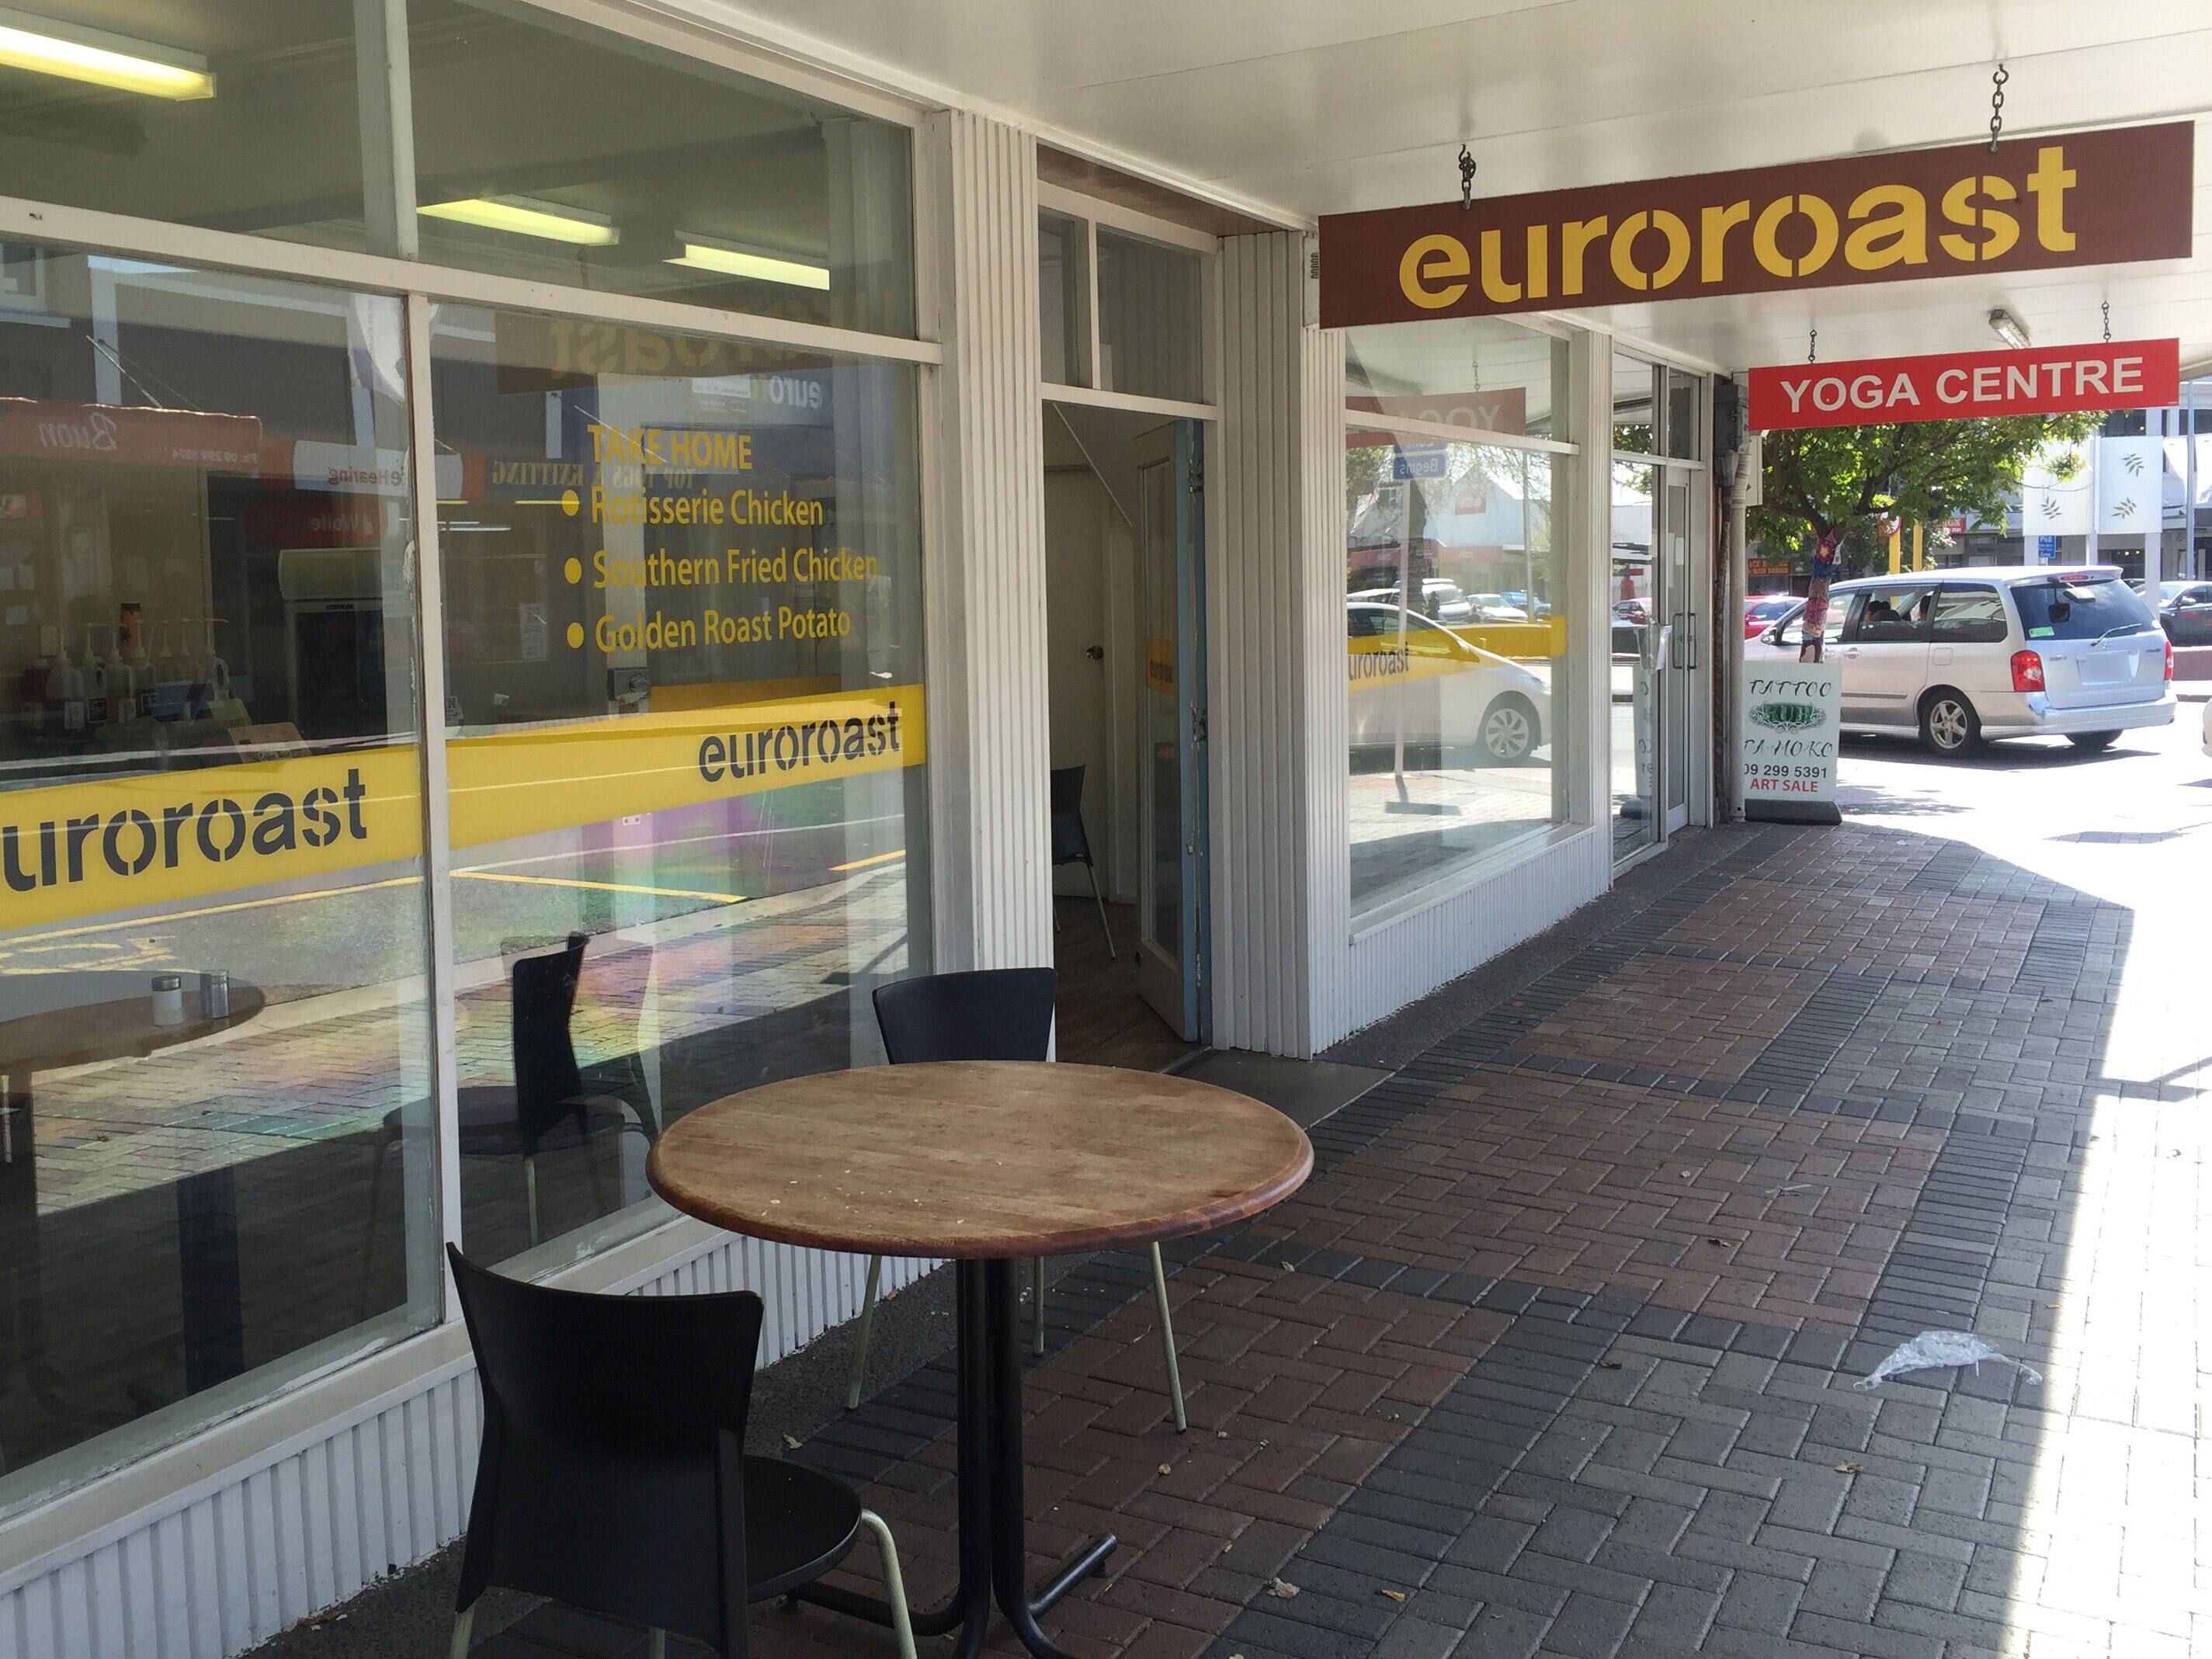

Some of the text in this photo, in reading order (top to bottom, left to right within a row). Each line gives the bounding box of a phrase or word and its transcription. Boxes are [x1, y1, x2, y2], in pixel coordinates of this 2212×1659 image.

[1398, 146, 2076, 309] euroroast
[1780, 356, 2144, 413] YOGA CENTRE
[587, 424, 752, 470] TAKE HOME
[591, 485, 824, 526] Rotisserie Chicken
[593, 547, 878, 588] Southern Fried Chicken
[596, 606, 852, 653] Golden Roast Potato
[1749, 679, 1832, 697] TATTOO
[699, 701, 900, 783] euroroast
[1749, 779, 1818, 793] ART SALE
[1763, 764, 1789, 777] 299
[1794, 766, 1828, 779] 5391
